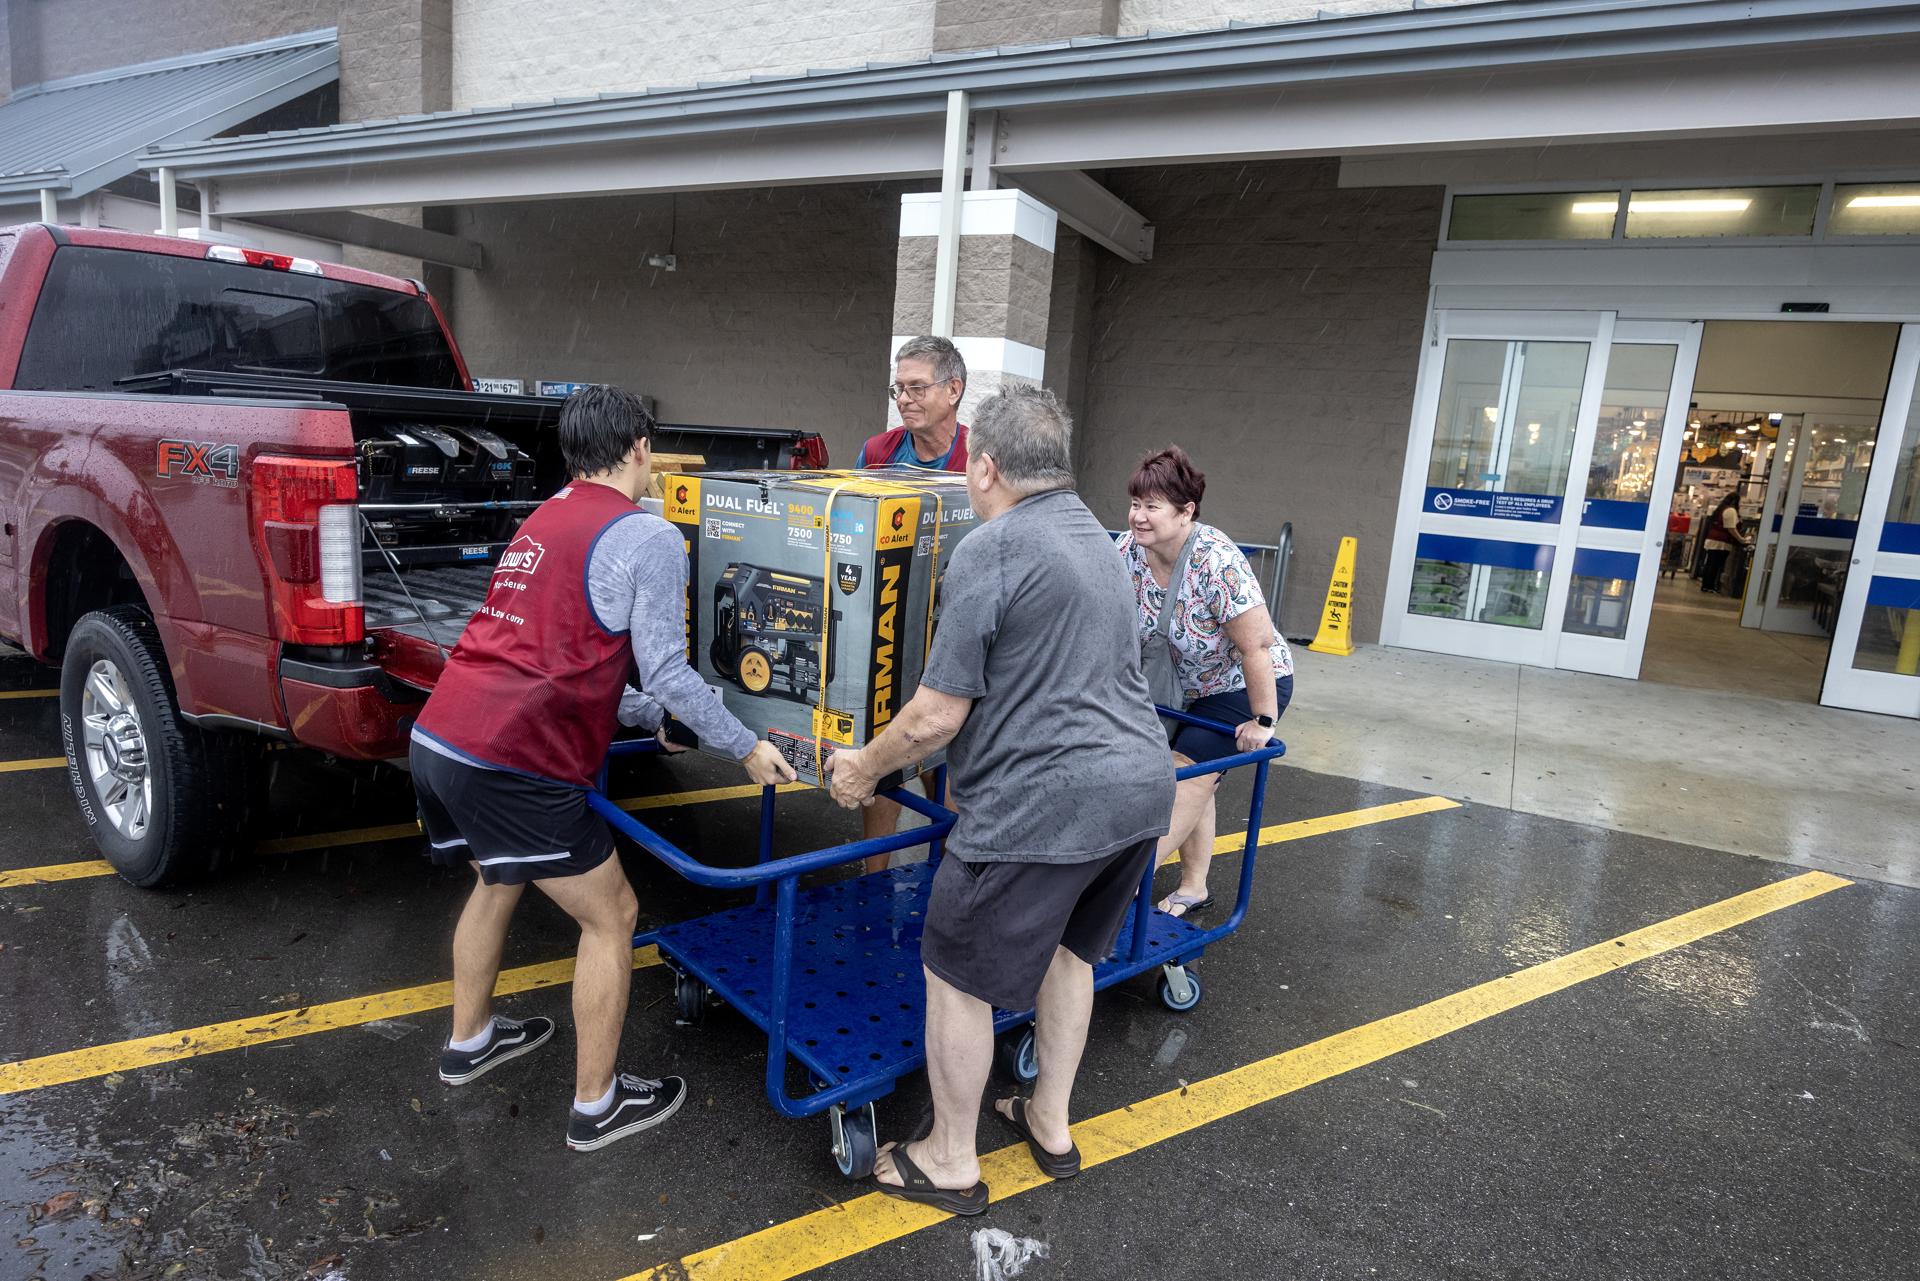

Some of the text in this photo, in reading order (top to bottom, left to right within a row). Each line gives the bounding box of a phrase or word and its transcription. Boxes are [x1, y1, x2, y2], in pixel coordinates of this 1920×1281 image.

[157, 438, 239, 480] FX4
[706, 493, 742, 511] DUAL
[1453, 497, 1490, 506] SMOKE-FREE
[677, 506, 696, 516] Alert
[788, 503, 814, 515] 9400
[951, 508, 974, 521] FUEL
[721, 520, 745, 529] CONNECT
[787, 526, 813, 539] 7500
[880, 533, 909, 545] CO Alert
[462, 546, 489, 555] REESE
[845, 565, 853, 576] 4
[873, 564, 901, 738] IRMAN
[62, 713, 98, 826] MICHELIN
